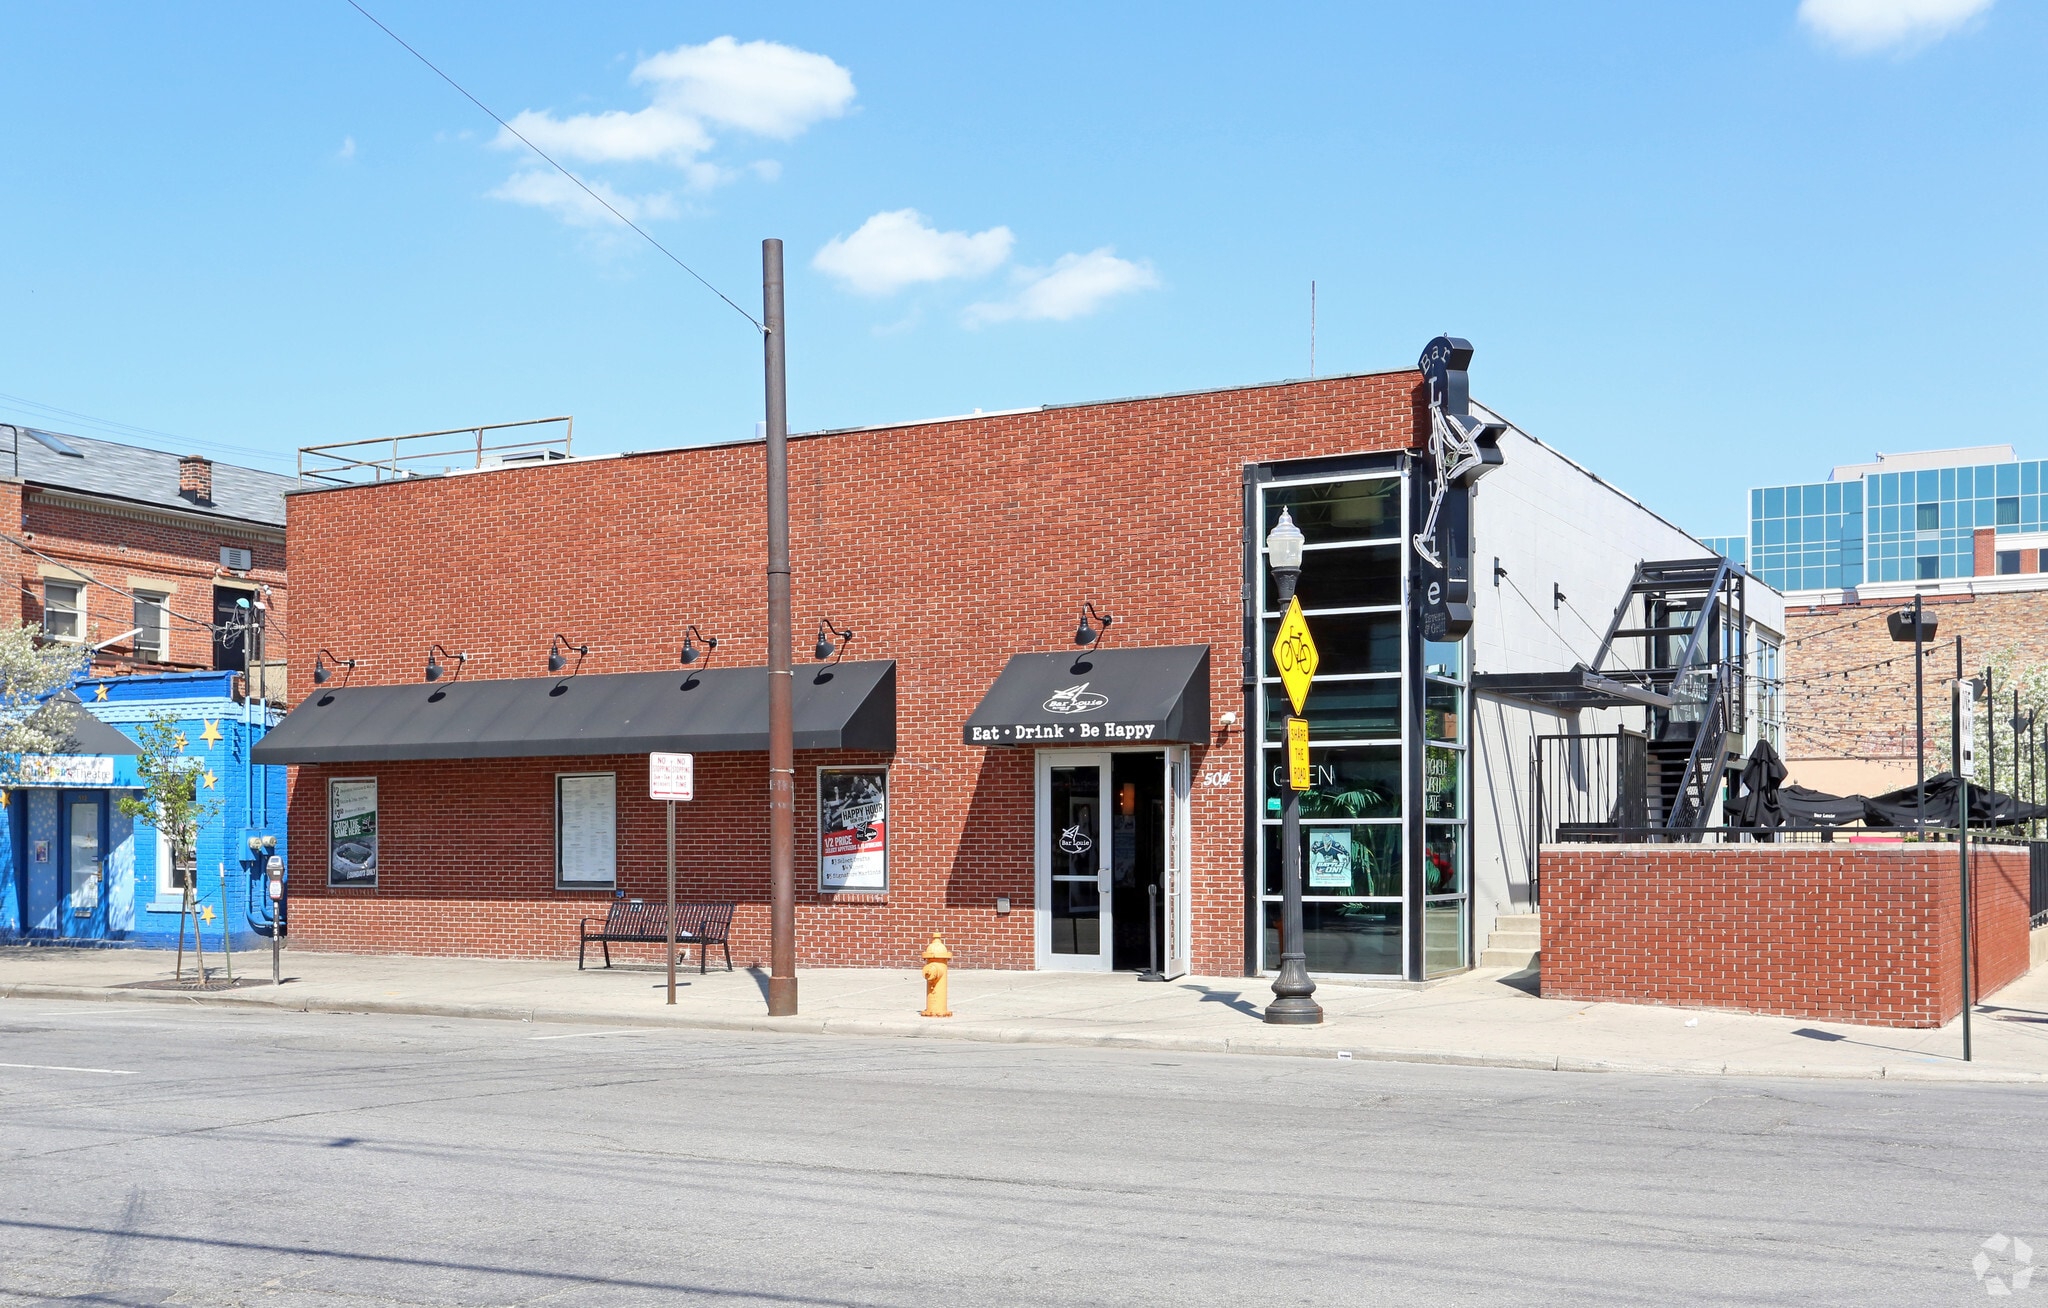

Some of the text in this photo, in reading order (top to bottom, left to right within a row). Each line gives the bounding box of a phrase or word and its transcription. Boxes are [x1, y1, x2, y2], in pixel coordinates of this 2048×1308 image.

[1421, 345, 1451, 375] Bar
[1070, 698, 1103, 707] Louie
[972, 722, 1156, 741] Eat Drink Be Happy
[1291, 727, 1307, 742] SHARE
[1295, 747, 1304, 761] THE
[75, 766, 112, 780] Theatre
[1203, 771, 1232, 787] 504
[1273, 764, 1333, 787] OEN
[1293, 766, 1306, 780] ROAD
[842, 807, 864, 820] HAPPY
[865, 803, 884, 815] HOUR
[333, 819, 360, 830] CATCH THE
[334, 828, 348, 838] GAME
[348, 826, 361, 836] HERE
[824, 835, 852, 848] 1/2 PRICE
